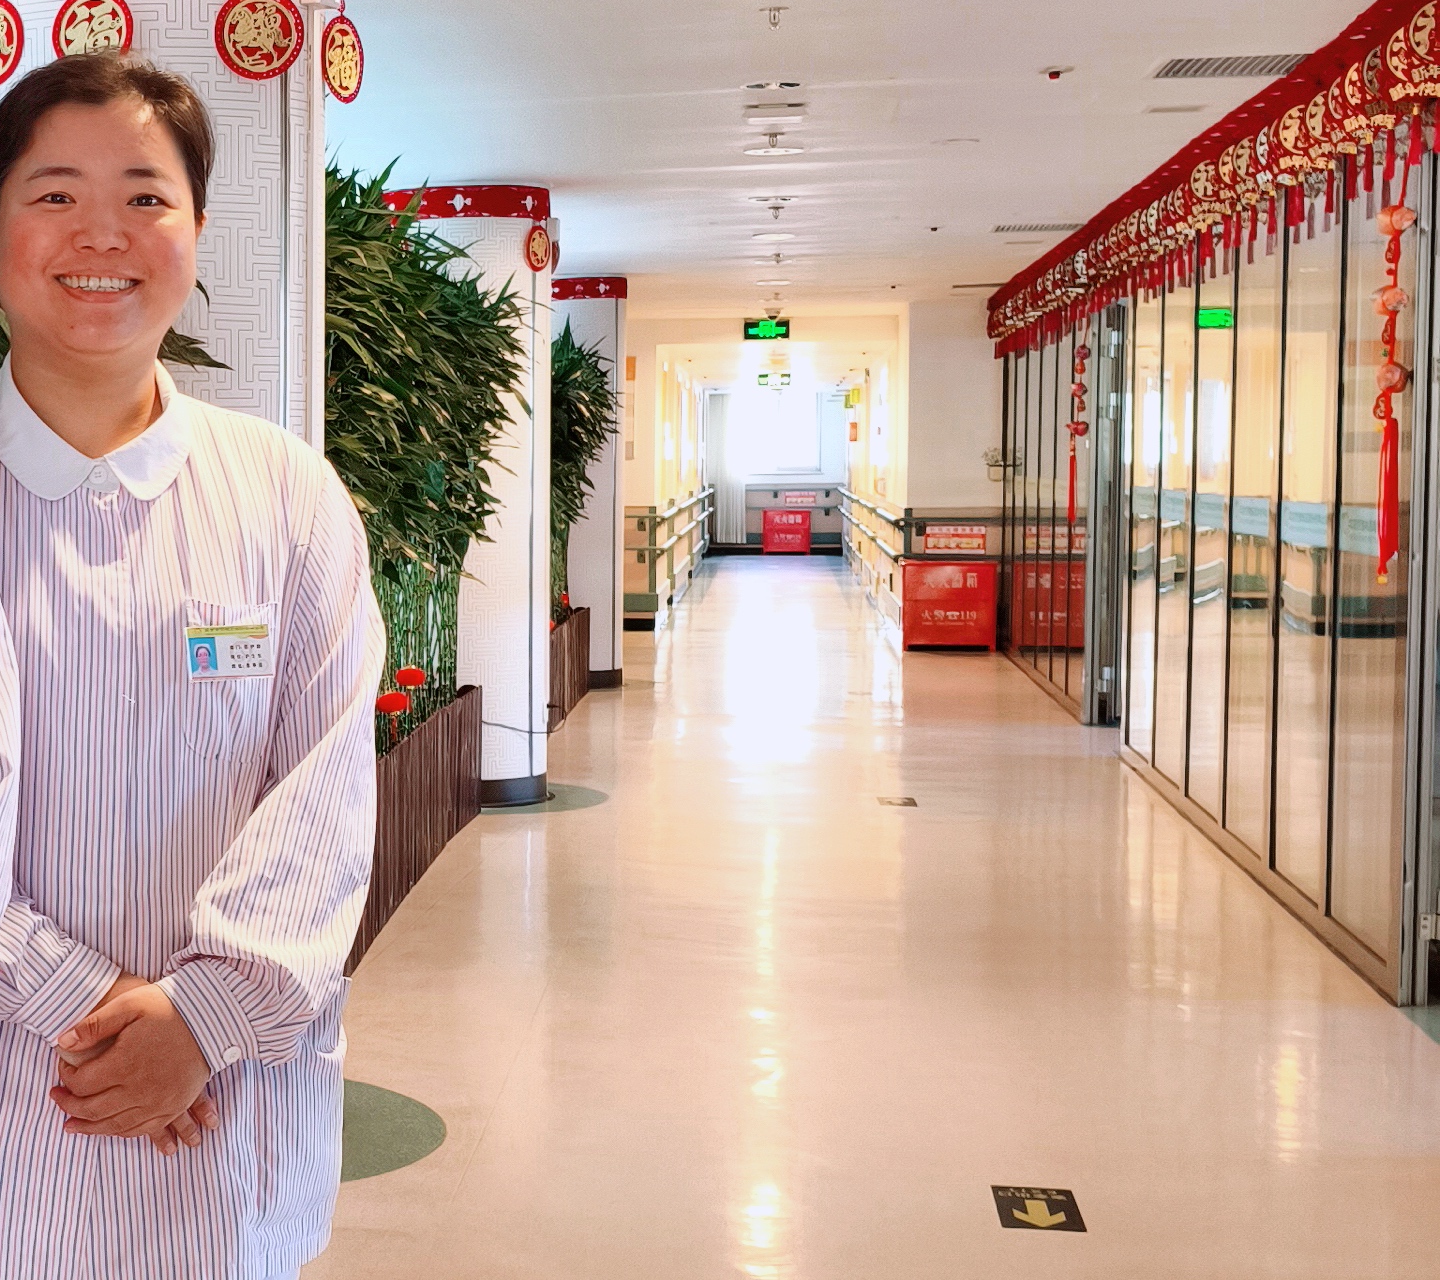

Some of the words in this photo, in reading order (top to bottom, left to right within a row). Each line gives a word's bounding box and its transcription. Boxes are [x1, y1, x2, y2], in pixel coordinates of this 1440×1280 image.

[66, 1, 123, 57] 福
[328, 31, 358, 88] 福
[960, 610, 977, 621] 119
